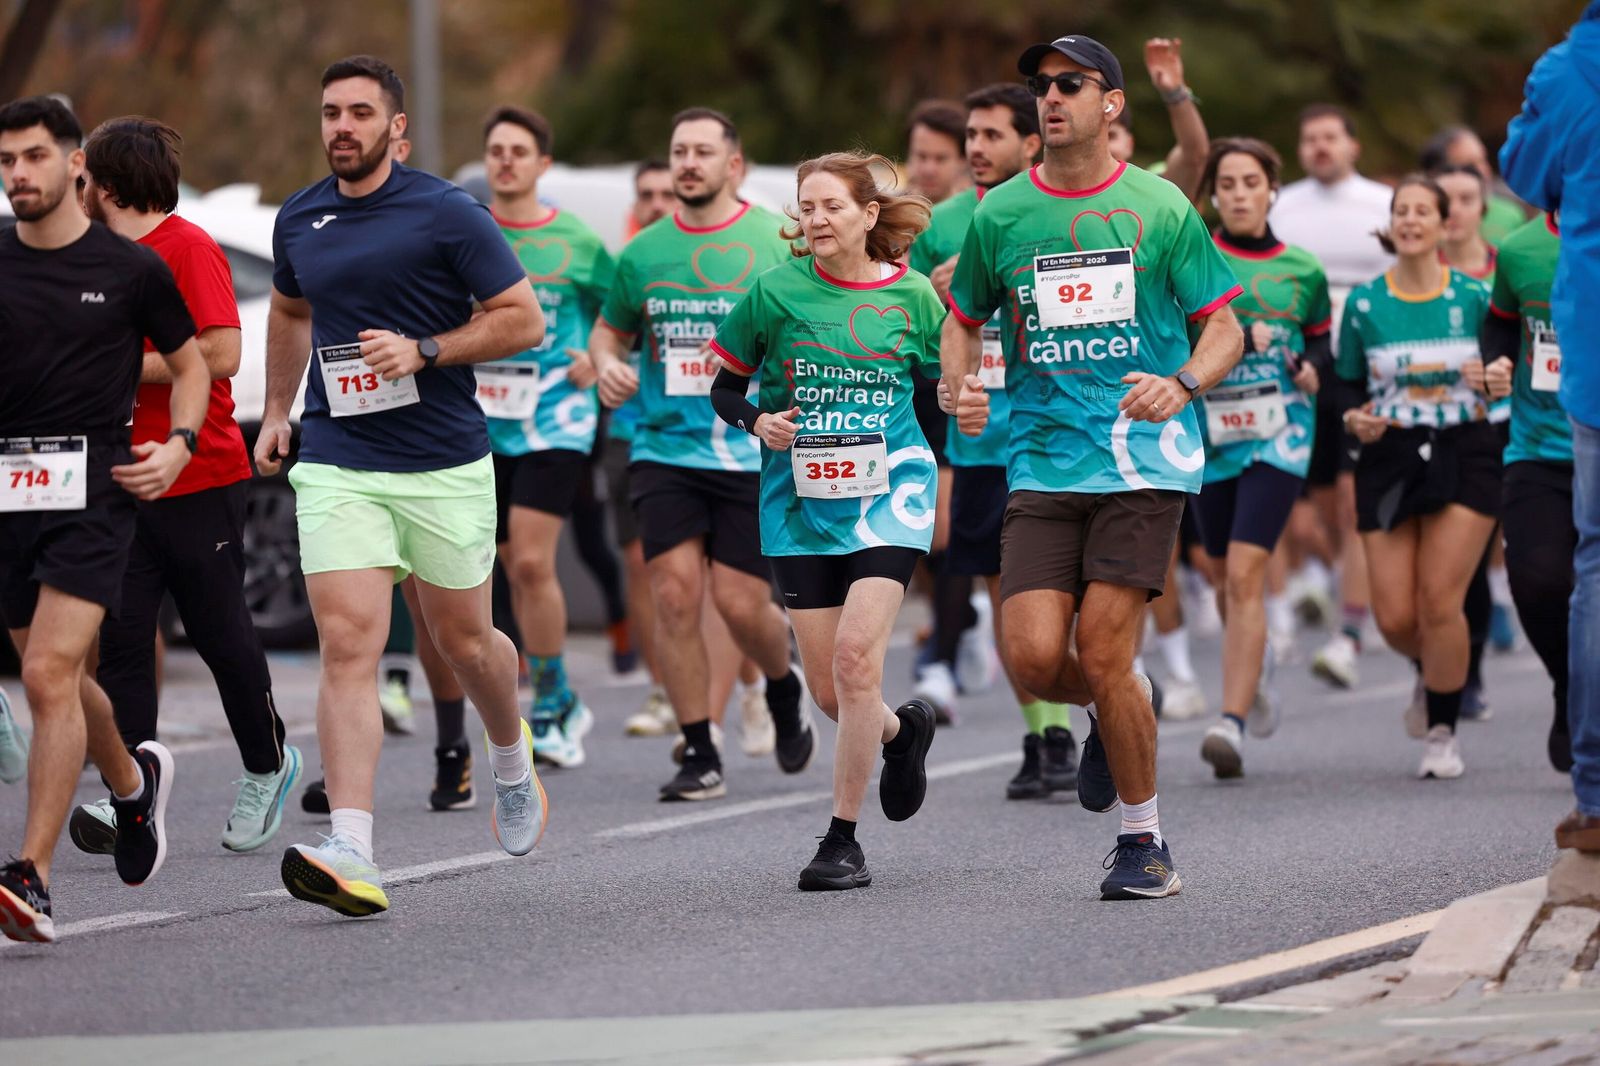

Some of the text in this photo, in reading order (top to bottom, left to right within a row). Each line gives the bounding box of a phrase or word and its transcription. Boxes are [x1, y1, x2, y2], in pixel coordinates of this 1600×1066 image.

[1059, 256, 1083, 264] Marcha
[1086, 255, 1107, 264] 2026
[81, 291, 105, 303] FILA
[1058, 283, 1093, 303] 92
[646, 297, 737, 315] En march
[652, 317, 716, 338] contra
[1029, 332, 1140, 364] cáncer
[795, 358, 818, 377] En
[823, 361, 900, 385] marcha
[337, 372, 379, 395] 713
[794, 385, 895, 407] contra el
[841, 436, 861, 444] 2026
[796, 451, 836, 459] #YoCorroPor
[10, 468, 50, 489] 714
[805, 460, 857, 480] 352
